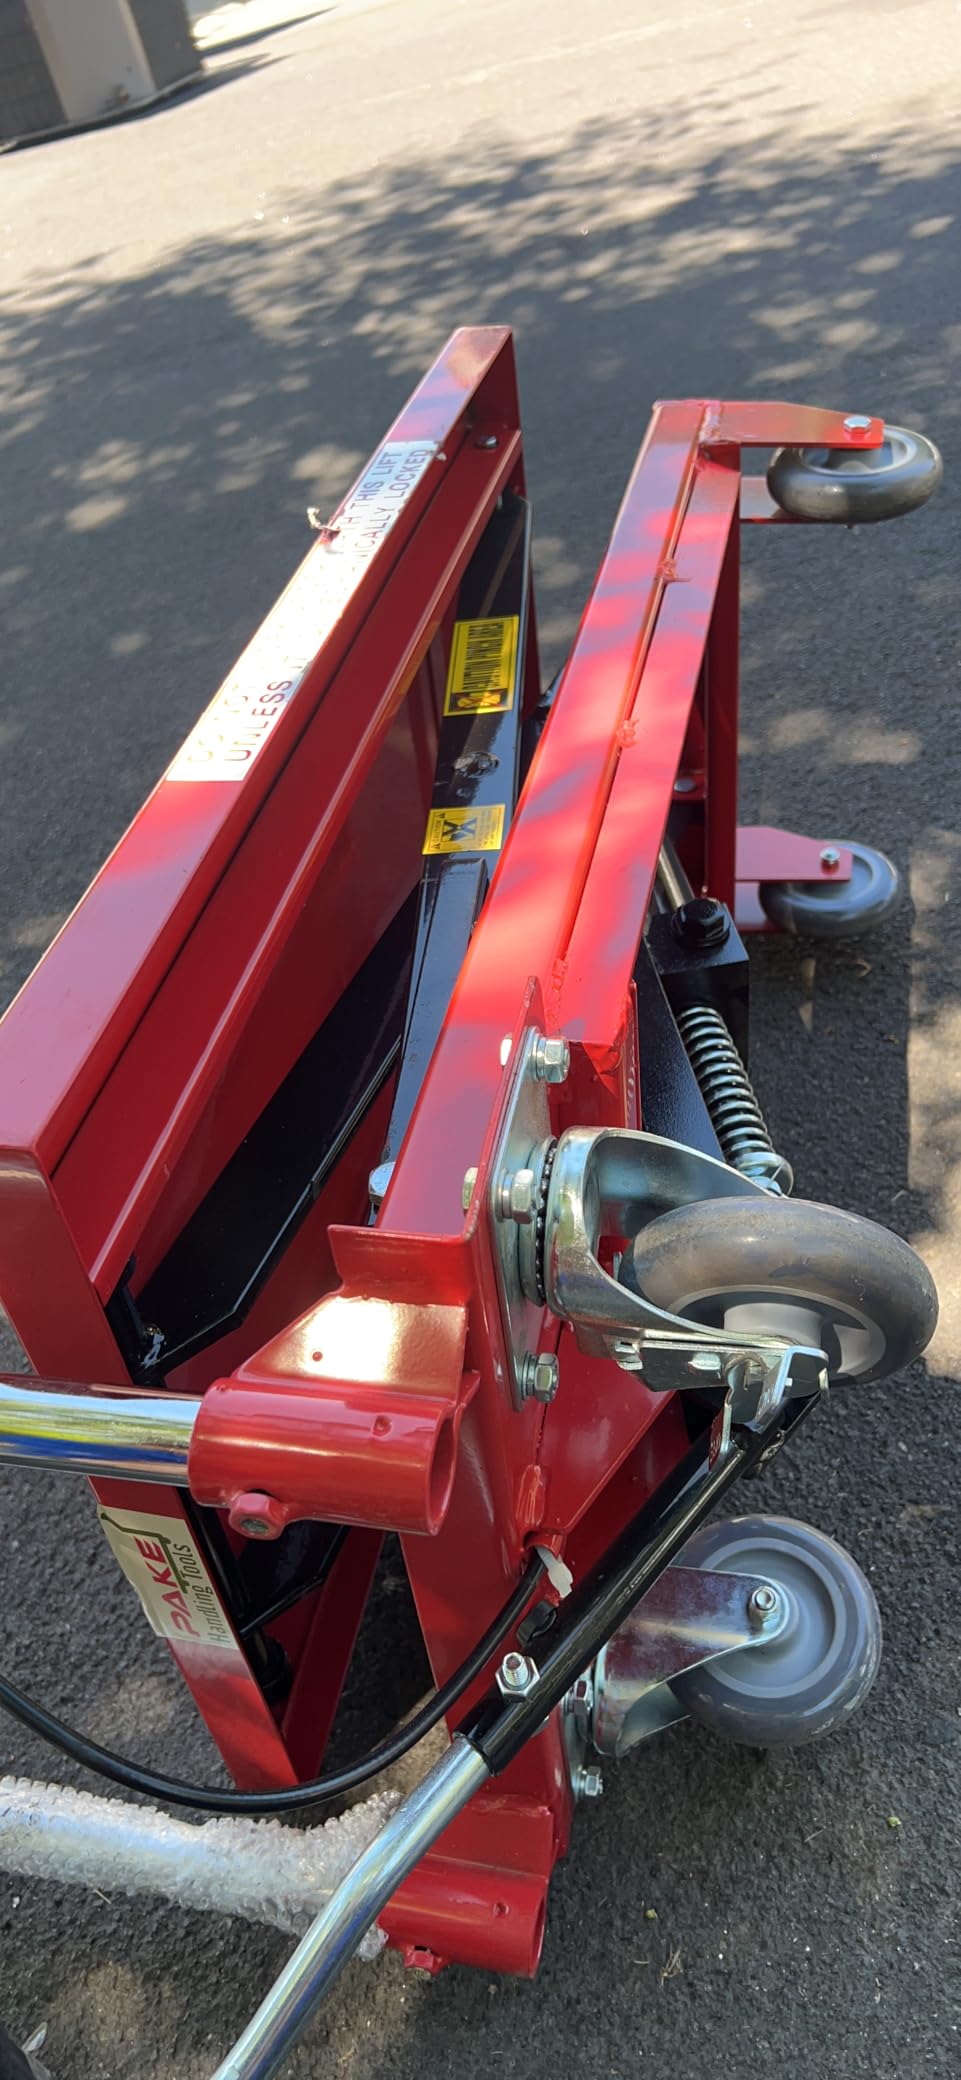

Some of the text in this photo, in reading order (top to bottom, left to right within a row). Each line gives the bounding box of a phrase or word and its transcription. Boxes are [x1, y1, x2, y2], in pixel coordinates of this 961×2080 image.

[351, 481, 384, 510] THIS
[371, 451, 402, 476] LIFT
[223, 680, 293, 762] UNLESS
[384, 449, 430, 499] LOCKED
[133, 1535, 201, 1637] PAKE
[172, 1543, 231, 1644] Handling Tools
